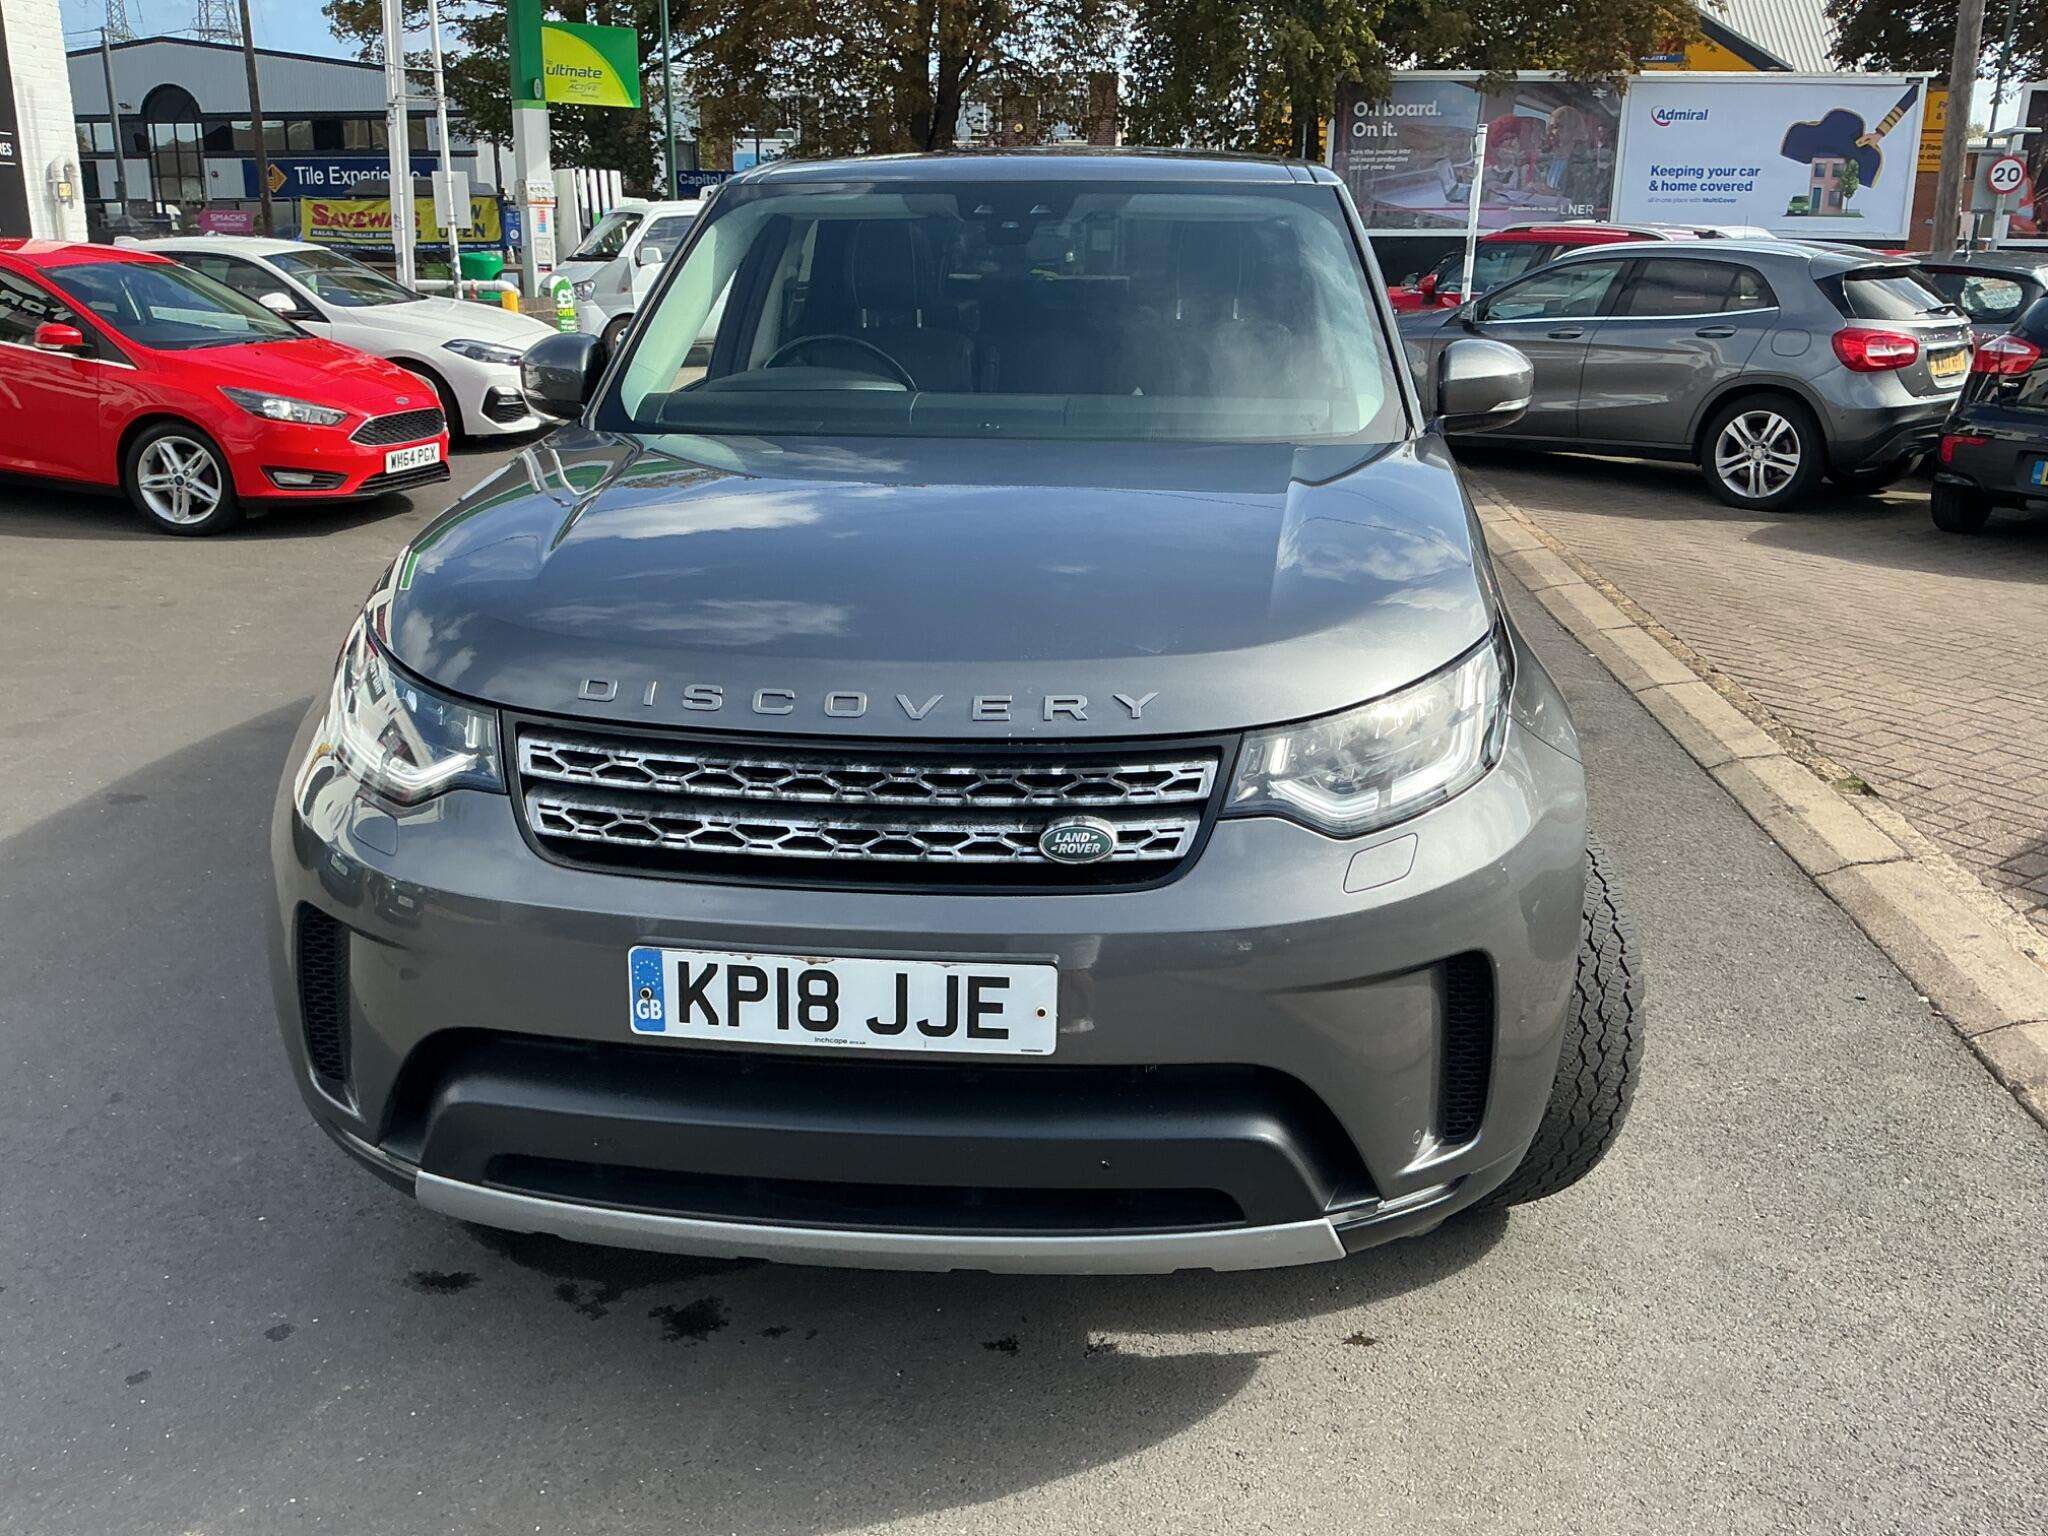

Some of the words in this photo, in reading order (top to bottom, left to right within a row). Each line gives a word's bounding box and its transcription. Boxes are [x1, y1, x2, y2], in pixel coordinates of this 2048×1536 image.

[546, 64, 603, 79] ultimate
[1383, 100, 1442, 117] board.
[1656, 109, 1709, 121] Admiral
[1352, 121, 1379, 138] On
[1382, 121, 1398, 137] it.
[294, 166, 325, 185] Tile
[329, 166, 421, 186] Experie
[679, 173, 722, 187] Capitol
[1650, 165, 1704, 179] Keeping
[1707, 167, 1737, 179] your
[1739, 168, 1761, 177] car
[1994, 167, 2021, 183] 20
[1648, 180, 1659, 192] &
[1661, 180, 1697, 192] home
[1700, 180, 1754, 192] covered
[312, 203, 421, 229] SAVEWAS
[1560, 203, 1594, 215] LNER
[438, 222, 486, 239] OEN
[391, 450, 416, 469] WH64
[418, 445, 436, 464] PGX
[577, 678, 1159, 722] DISCOVERY
[1055, 832, 1091, 843] LAND
[1057, 843, 1101, 854] ROVER
[677, 961, 840, 1033] KP18
[866, 972, 1010, 1040] JJE
[636, 1000, 662, 1020] GB
